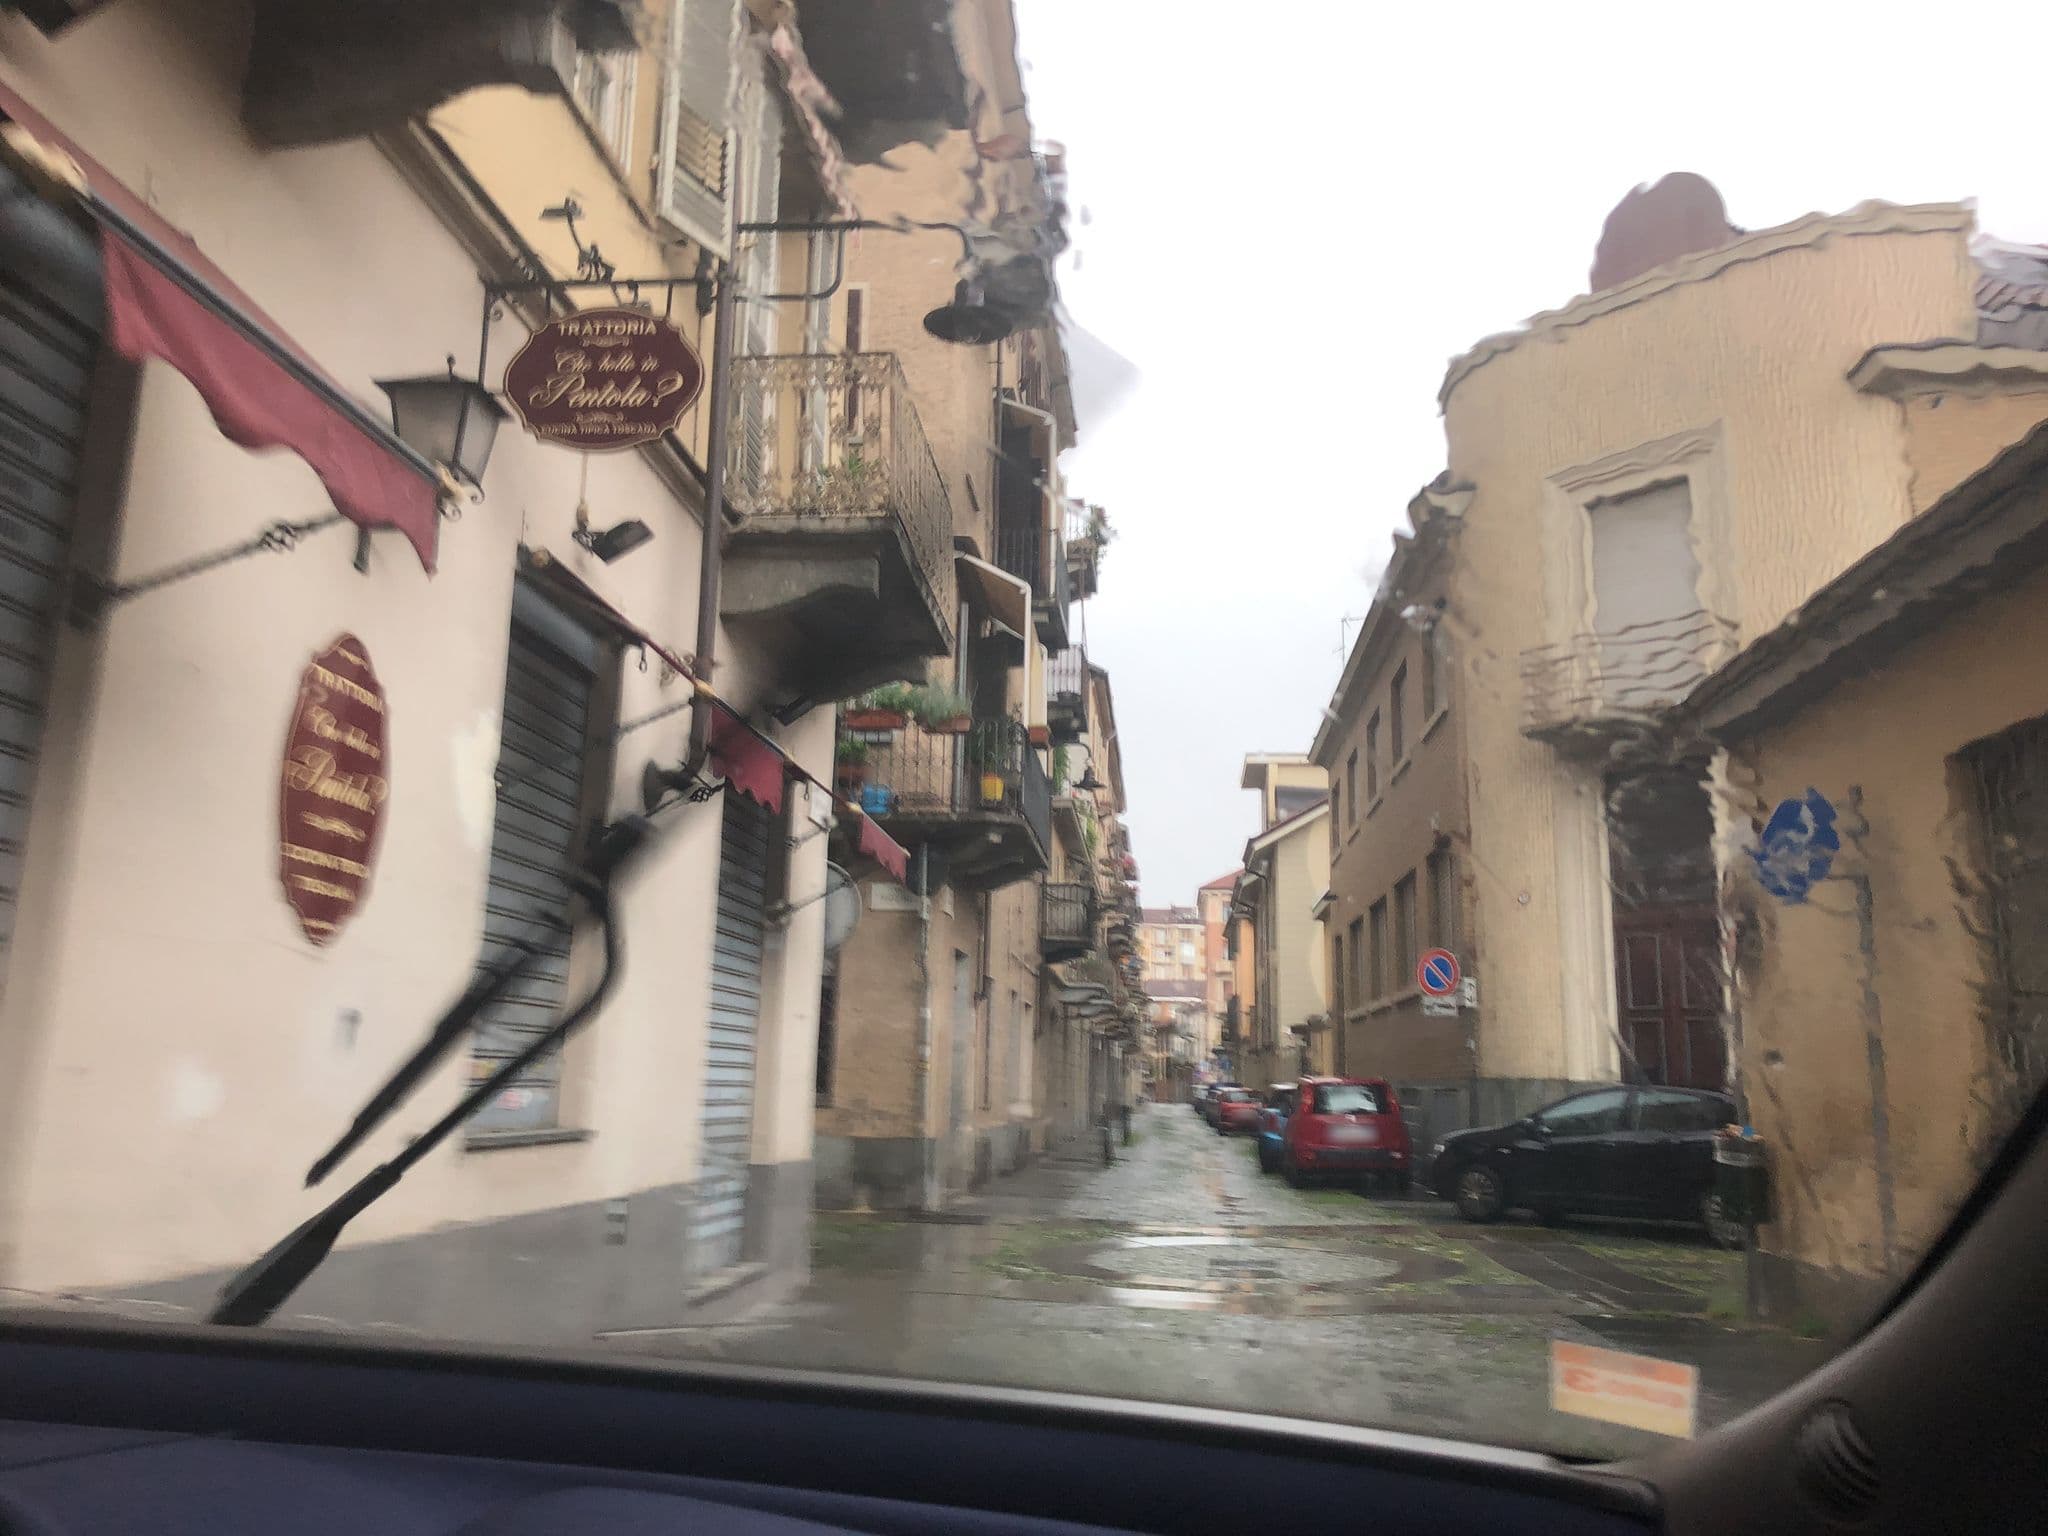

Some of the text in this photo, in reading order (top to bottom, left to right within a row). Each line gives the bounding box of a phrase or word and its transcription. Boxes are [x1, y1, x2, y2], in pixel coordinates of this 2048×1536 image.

[558, 319, 658, 336] TRATTORIA
[554, 347, 593, 374] Che
[641, 352, 660, 373] in
[528, 371, 684, 409] Pentola?
